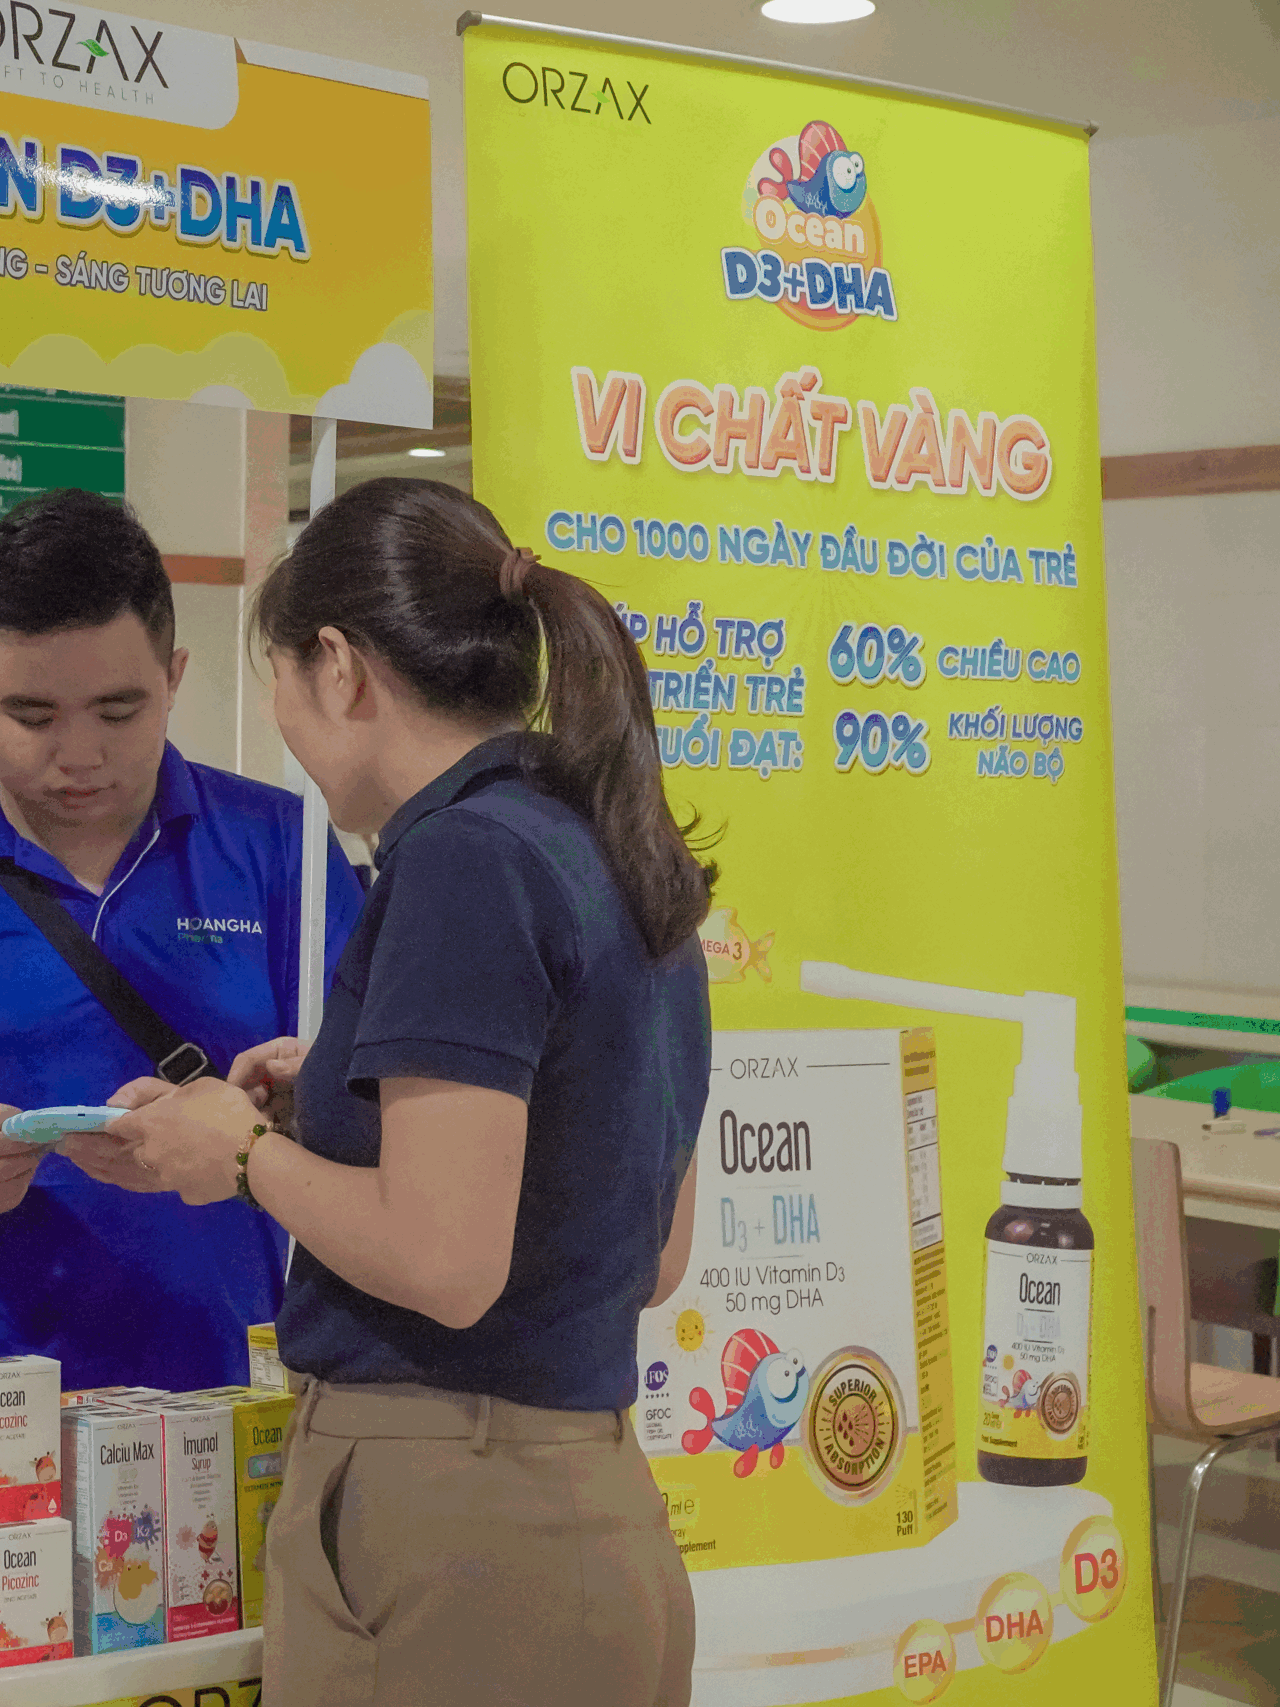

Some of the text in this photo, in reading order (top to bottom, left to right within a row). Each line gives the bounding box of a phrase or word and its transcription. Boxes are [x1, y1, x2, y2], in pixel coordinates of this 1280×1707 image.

[40, 69, 65, 88] TO
[80, 77, 155, 106] HEALTH
[503, 62, 652, 125] ORZAX
[58, 148, 307, 255] D3+DHA
[756, 198, 866, 256] Ocean
[56, 251, 130, 293] SÁNG
[136, 263, 226, 306] TƯƠNG
[232, 280, 269, 311] LAI
[724, 250, 896, 320] D3+DHA
[575, 368, 1050, 495] VI CHẤT VÀNG
[546, 512, 1078, 588] CHO 1000 NGÀY ĐẦU ĐỜI CỦA TRẺ
[656, 602, 706, 658] HỖ
[714, 618, 786, 669] TRỢ
[829, 622, 924, 687] 60%
[937, 637, 1082, 685] CHIỀU CAO
[648, 659, 805, 716] TRIỂN TRẺ
[834, 708, 931, 776] 90%
[949, 706, 1083, 750] KHỐI LƯỢNG
[728, 727, 803, 781] ĐẠT:
[977, 747, 1065, 784] NÃO BỘ
[176, 917, 263, 934] HOANGHA
[700, 938, 743, 960] MEGA 3
[730, 1056, 799, 1080] ORZAX
[720, 1109, 812, 1175] Ocean
[772, 1193, 821, 1245] DHA
[1026, 1252, 1058, 1265] ORZAX
[700, 1267, 730, 1289] 400
[735, 1267, 751, 1287] IU
[756, 1263, 821, 1286] Vitamin
[1020, 1272, 1061, 1306] Ocean
[726, 1289, 824, 1316] 50 mg DHA
[828, 1378, 877, 1406] SUPERIOR
[645, 1408, 671, 1421] GFOC
[252, 1426, 282, 1445] Ocean
[100, 1441, 155, 1465] Calciu Max
[191, 1458, 211, 1472] Syrup
[824, 1436, 885, 1475] ABSORPTION
[896, 1510, 913, 1525] 130
[897, 1523, 913, 1537] Puff
[8, 1533, 31, 1541] ORZAX
[114, 1530, 128, 1542] D3
[679, 1539, 716, 1554] pplement
[4, 1549, 37, 1569] Ocean
[98, 1560, 113, 1572] Ca
[1074, 1548, 1118, 1594] D3
[1, 1572, 39, 1591] Picozinc
[985, 1610, 1043, 1642] DHA
[904, 1650, 946, 1678] EPA
